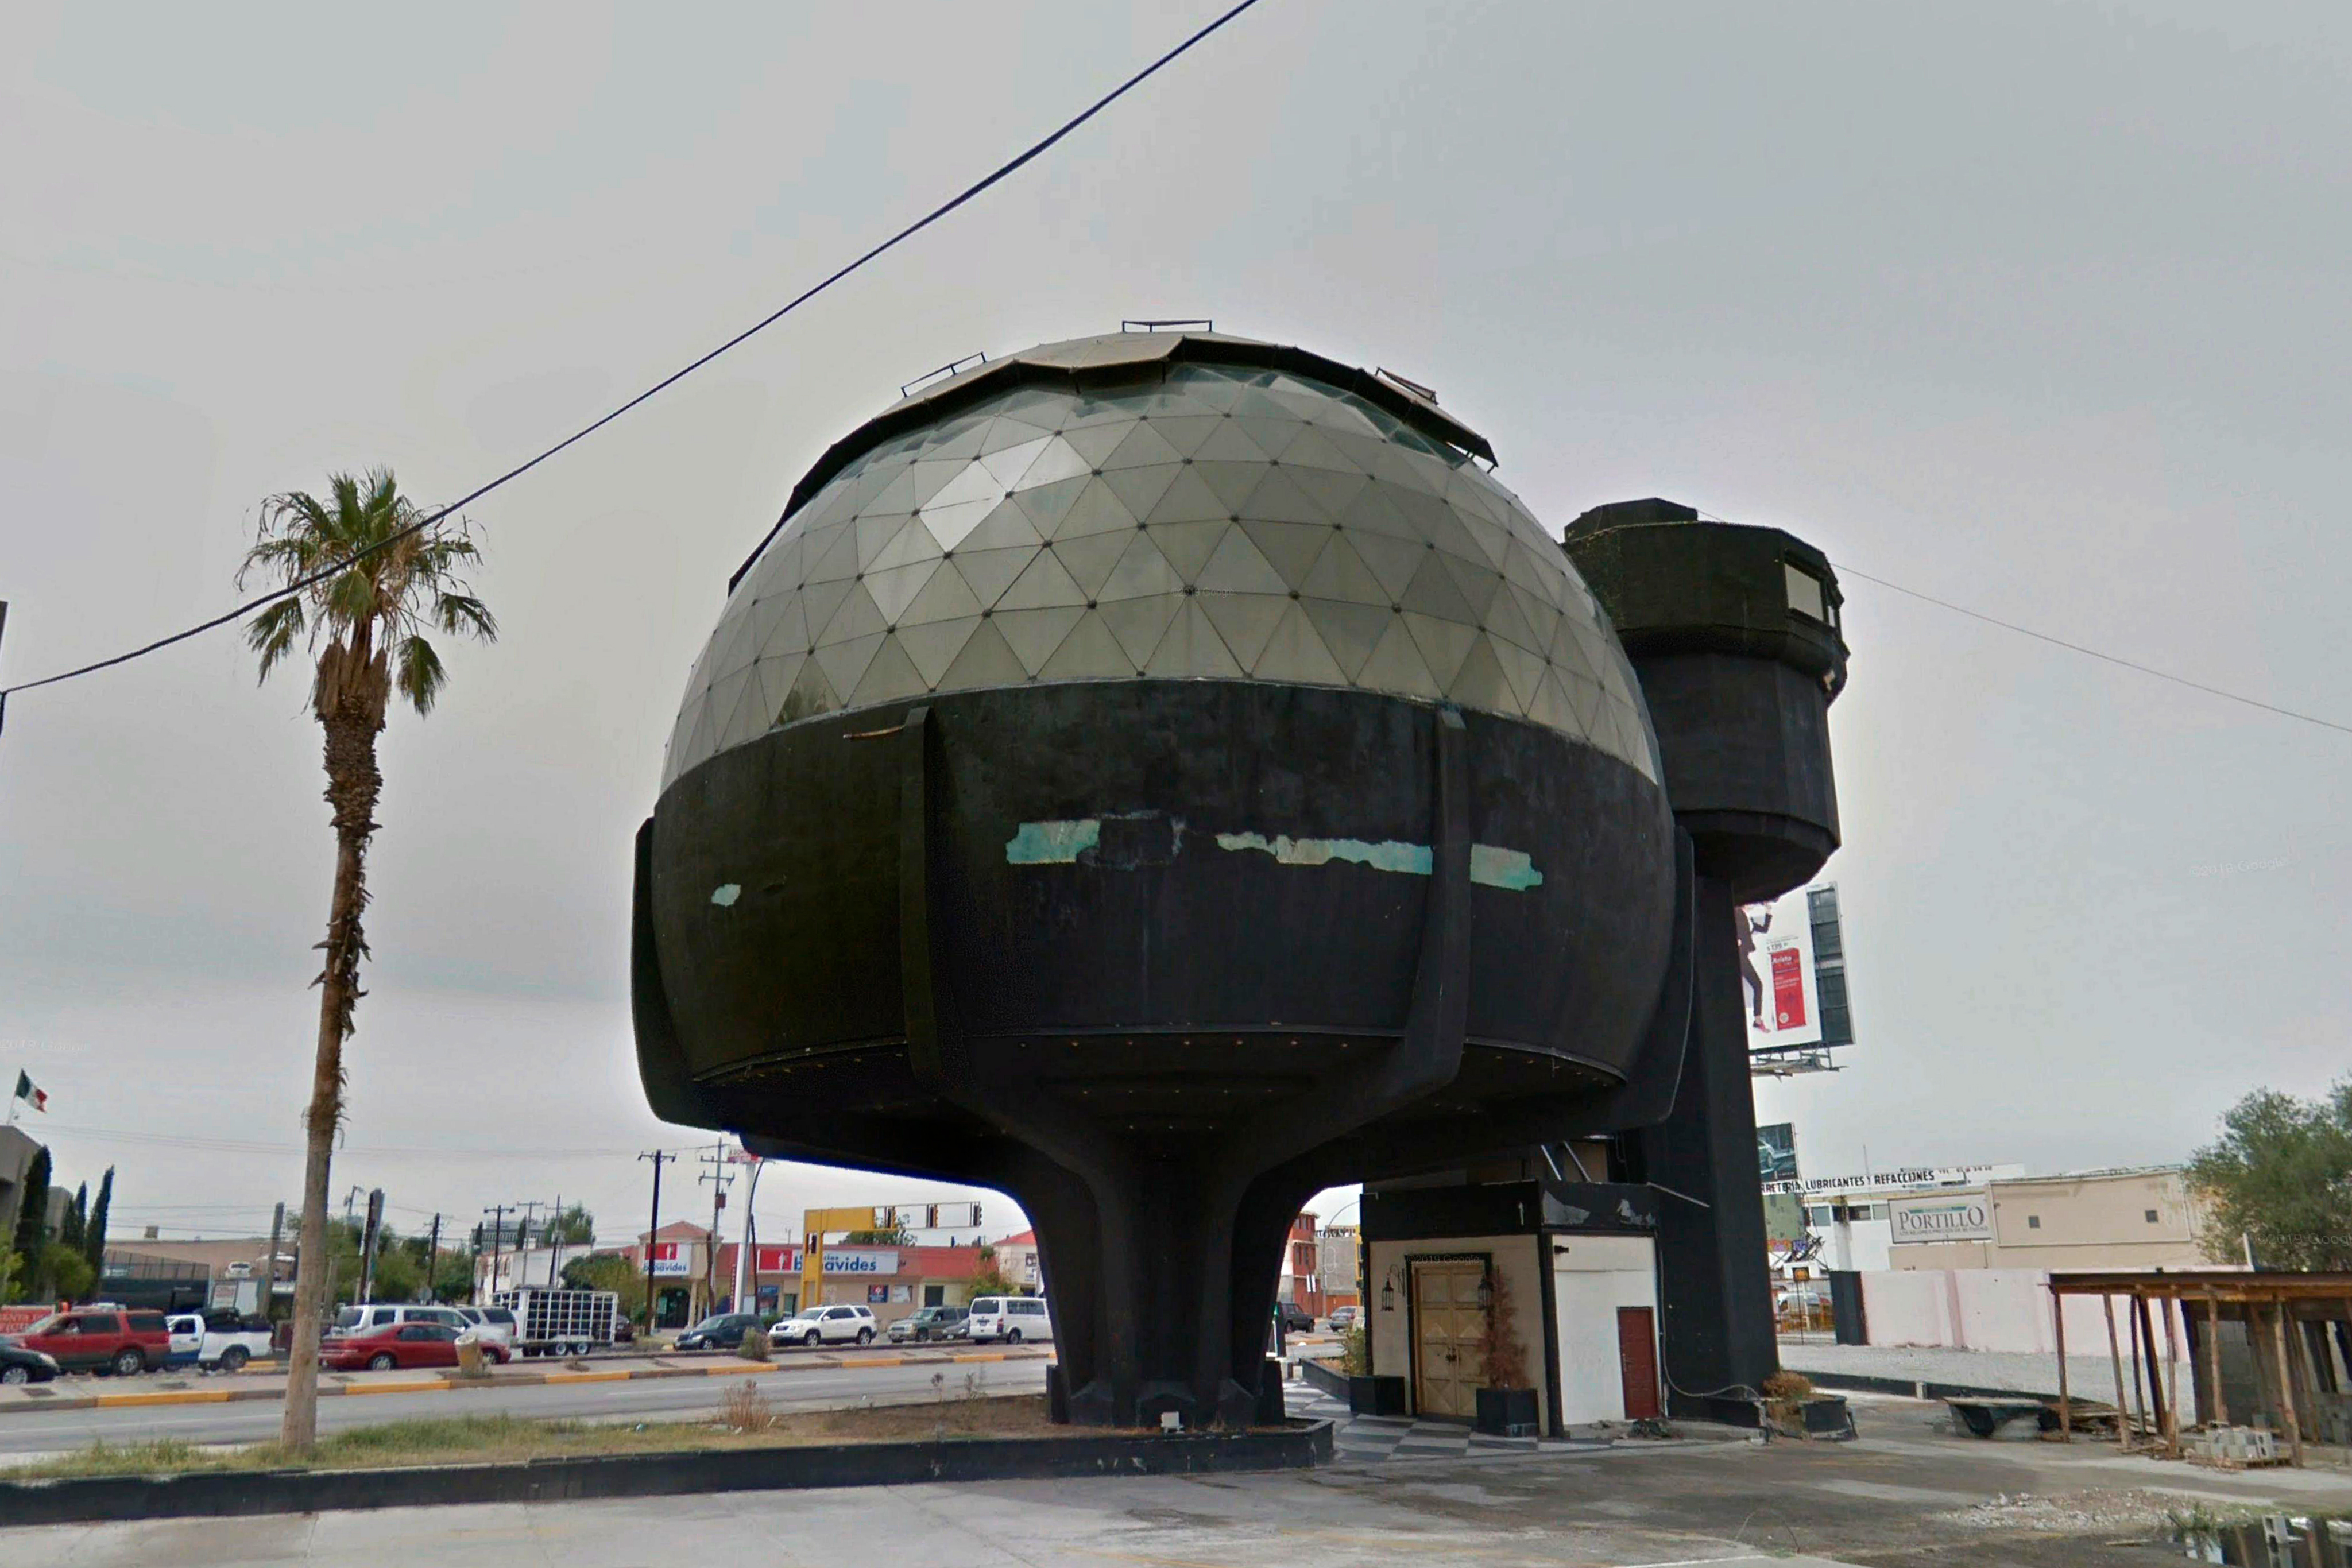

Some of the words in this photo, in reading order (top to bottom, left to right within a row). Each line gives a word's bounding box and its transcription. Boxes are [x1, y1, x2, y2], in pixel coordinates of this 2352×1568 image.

[1805, 1177, 1865, 1190] LUBRICANTES
[1898, 1206, 1984, 1230] PORTILLO
[643, 1262, 687, 1272] bnavides
[794, 1256, 877, 1272] bavides
